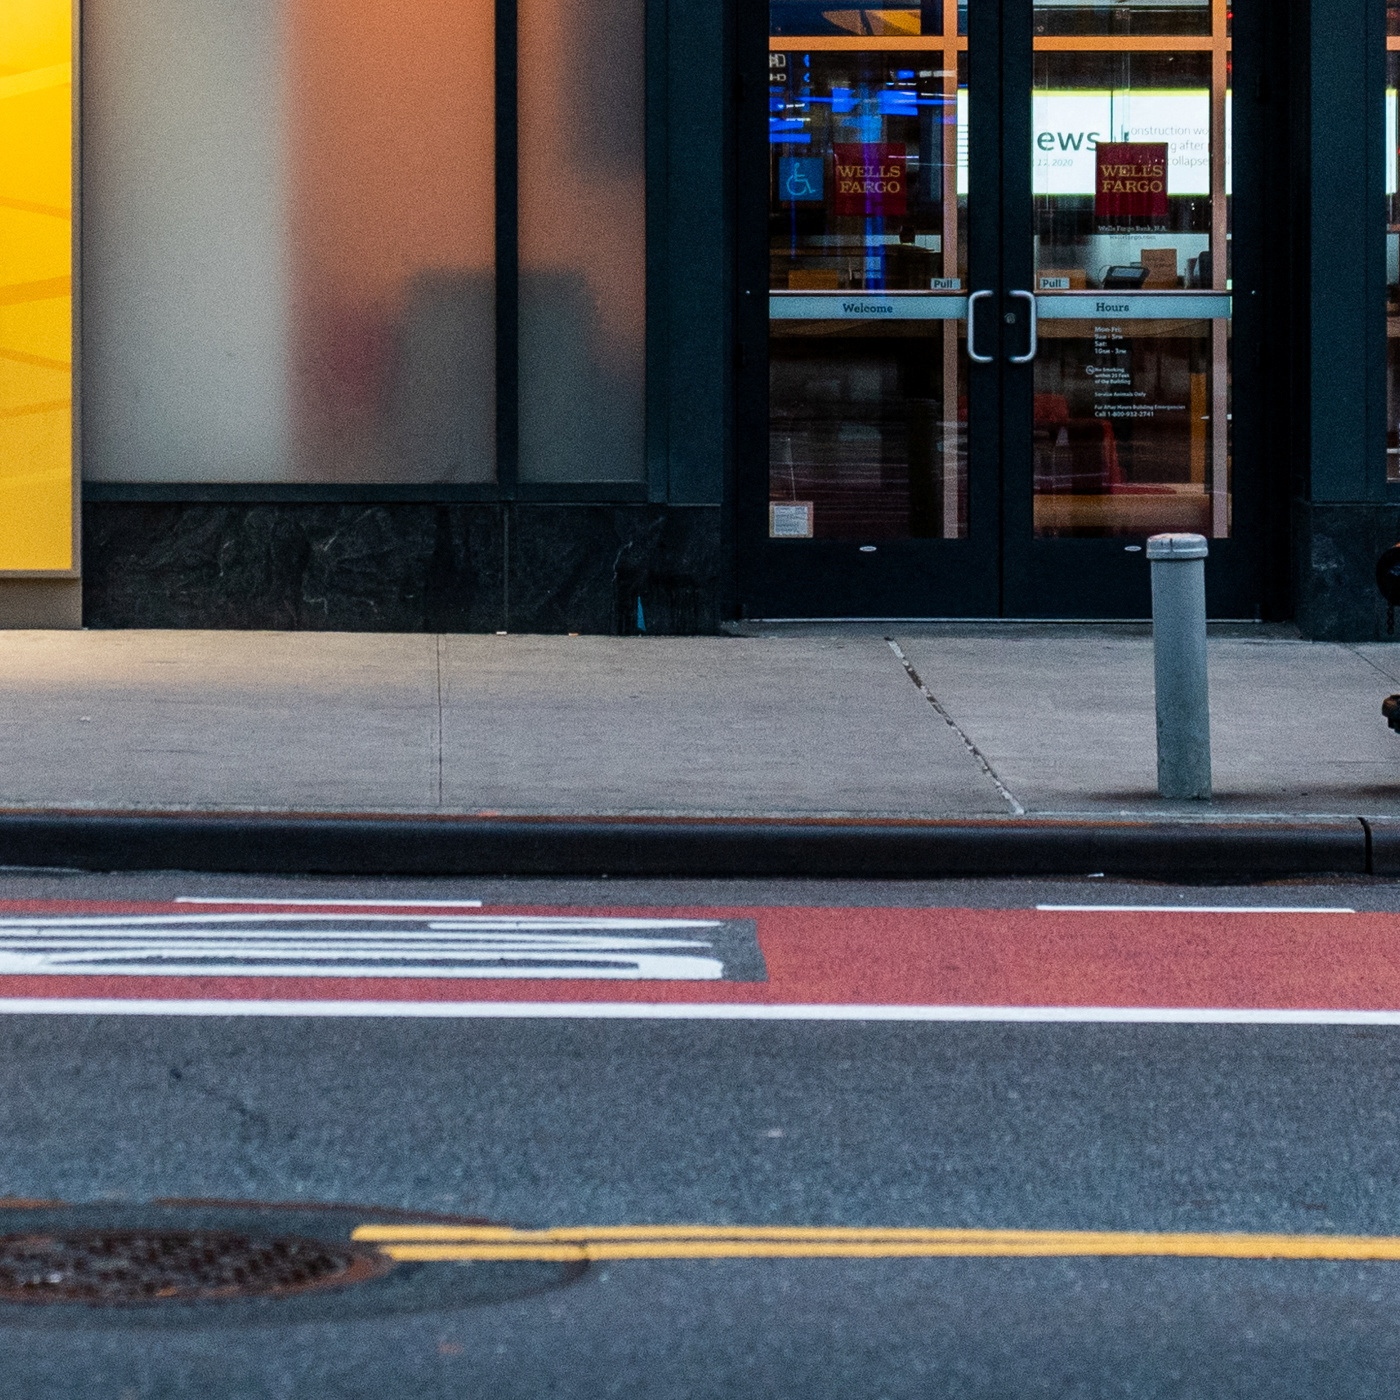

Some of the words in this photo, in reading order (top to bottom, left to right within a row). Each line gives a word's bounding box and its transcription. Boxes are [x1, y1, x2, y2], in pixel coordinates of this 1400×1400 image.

[1131, 126, 1191, 135] onstruction
[1036, 131, 1101, 151] ews
[1179, 140, 1205, 150] after
[1052, 159, 1074, 167] 2020
[1168, 156, 1208, 168] ollapse
[836, 165, 901, 178] WELLS
[1100, 165, 1164, 177] WELLS
[839, 180, 901, 194] FARGO
[1102, 180, 1163, 193] FARGO
[933, 279, 953, 289] Pull
[1042, 279, 1062, 289] Pull
[842, 303, 893, 313] Welcome
[1096, 302, 1130, 312] Hours
